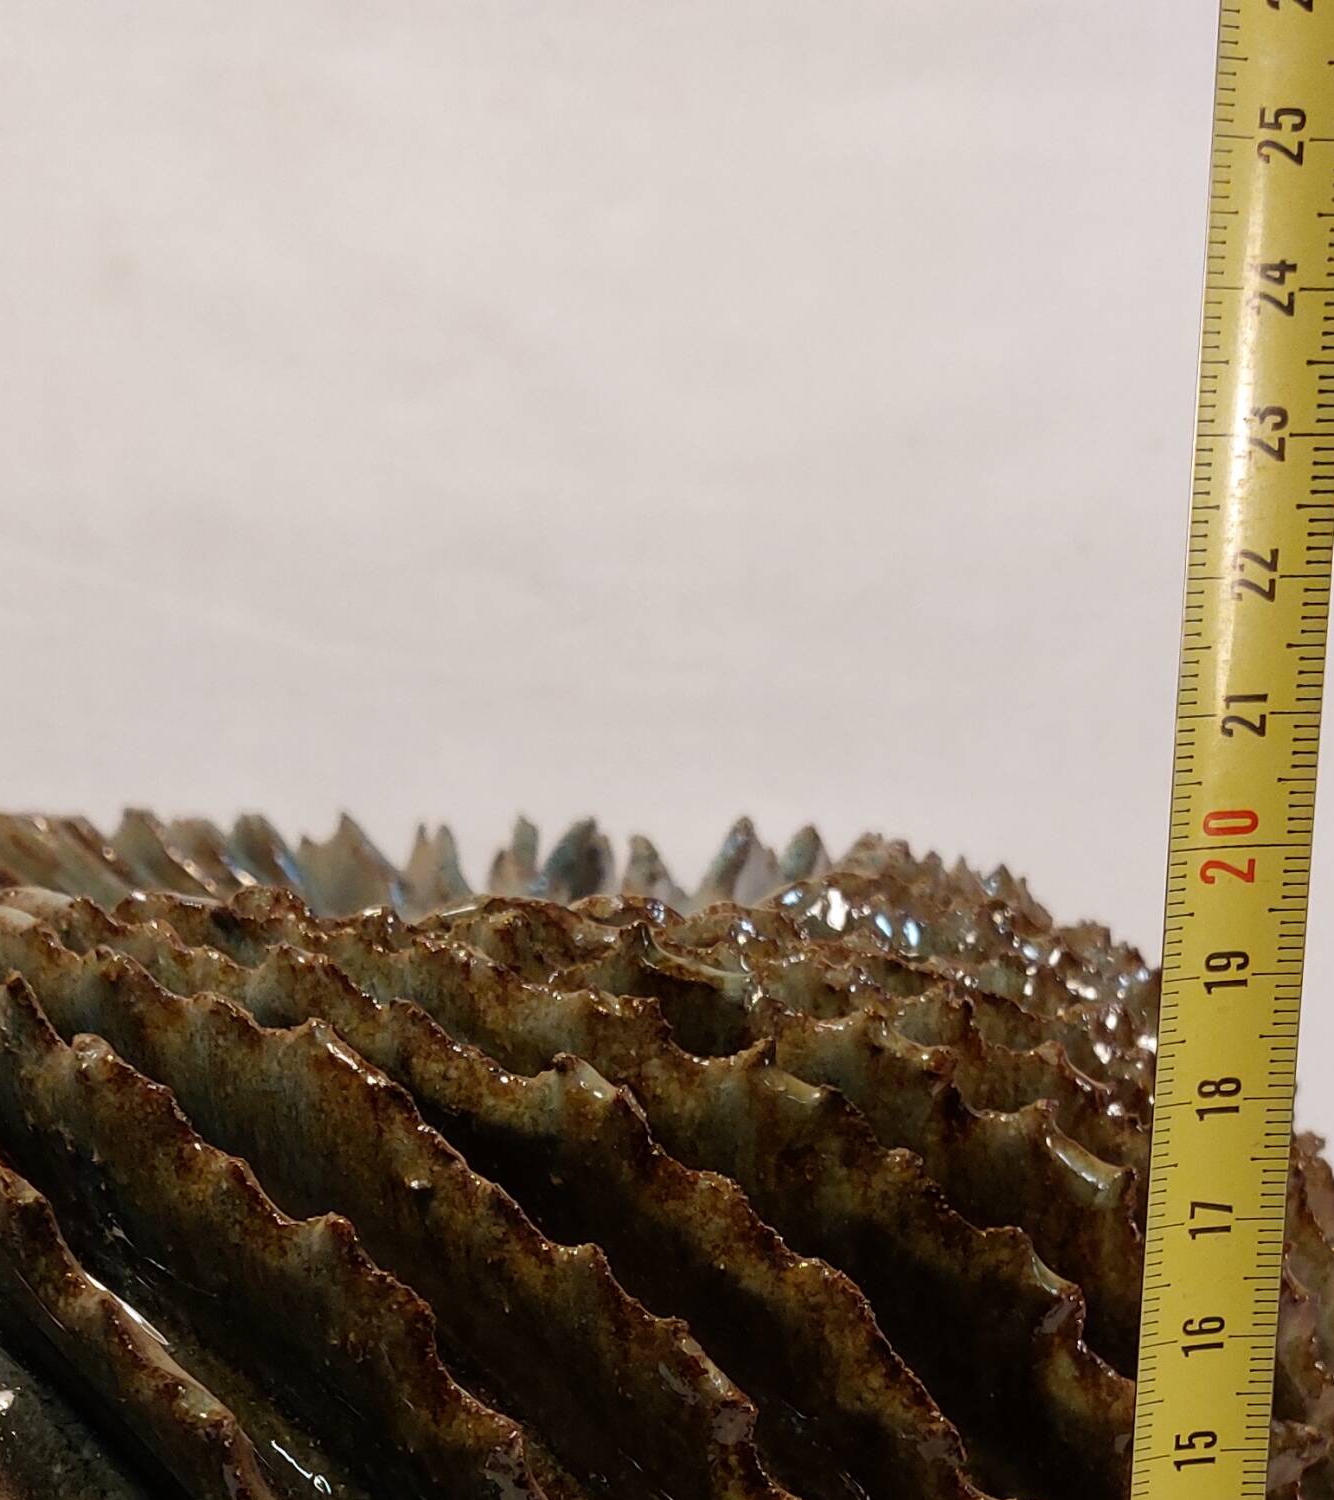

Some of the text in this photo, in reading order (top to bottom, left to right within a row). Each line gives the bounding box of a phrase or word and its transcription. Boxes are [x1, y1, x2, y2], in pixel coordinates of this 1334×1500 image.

[1257, 106, 1307, 166] 25
[1247, 258, 1298, 317] 24
[1244, 405, 1289, 462] 23
[1230, 548, 1279, 603] 22
[1221, 693, 1268, 738] 21
[1200, 809, 1259, 885] 20
[1203, 950, 1250, 995] 19
[1195, 1076, 1242, 1122] 18
[1188, 1200, 1234, 1240] 17
[1181, 1315, 1226, 1357] 16
[1173, 1430, 1218, 1472] 15
